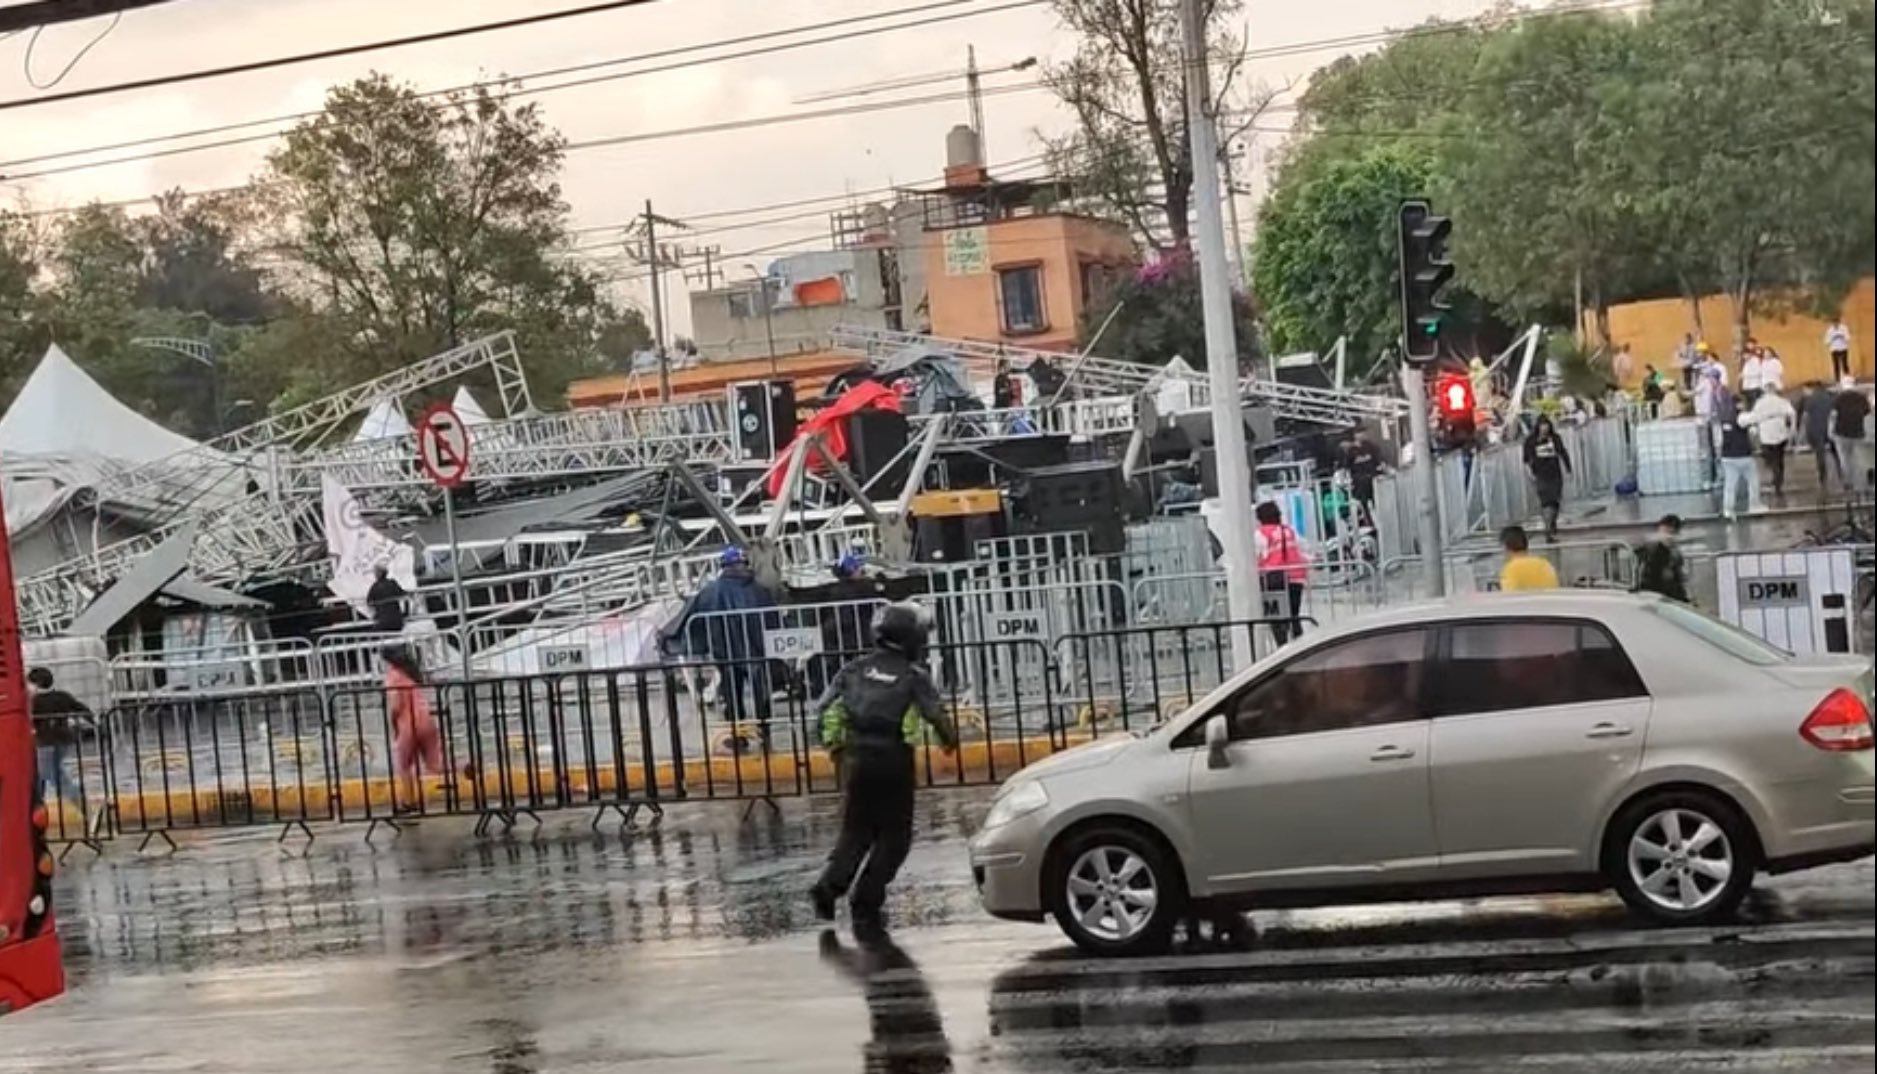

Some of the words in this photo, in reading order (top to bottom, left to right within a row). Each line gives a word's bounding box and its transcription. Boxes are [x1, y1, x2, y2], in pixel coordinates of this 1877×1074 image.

[1749, 582, 1798, 600] DPM
[997, 618, 1039, 635] DPM
[546, 650, 582, 667] DPM
